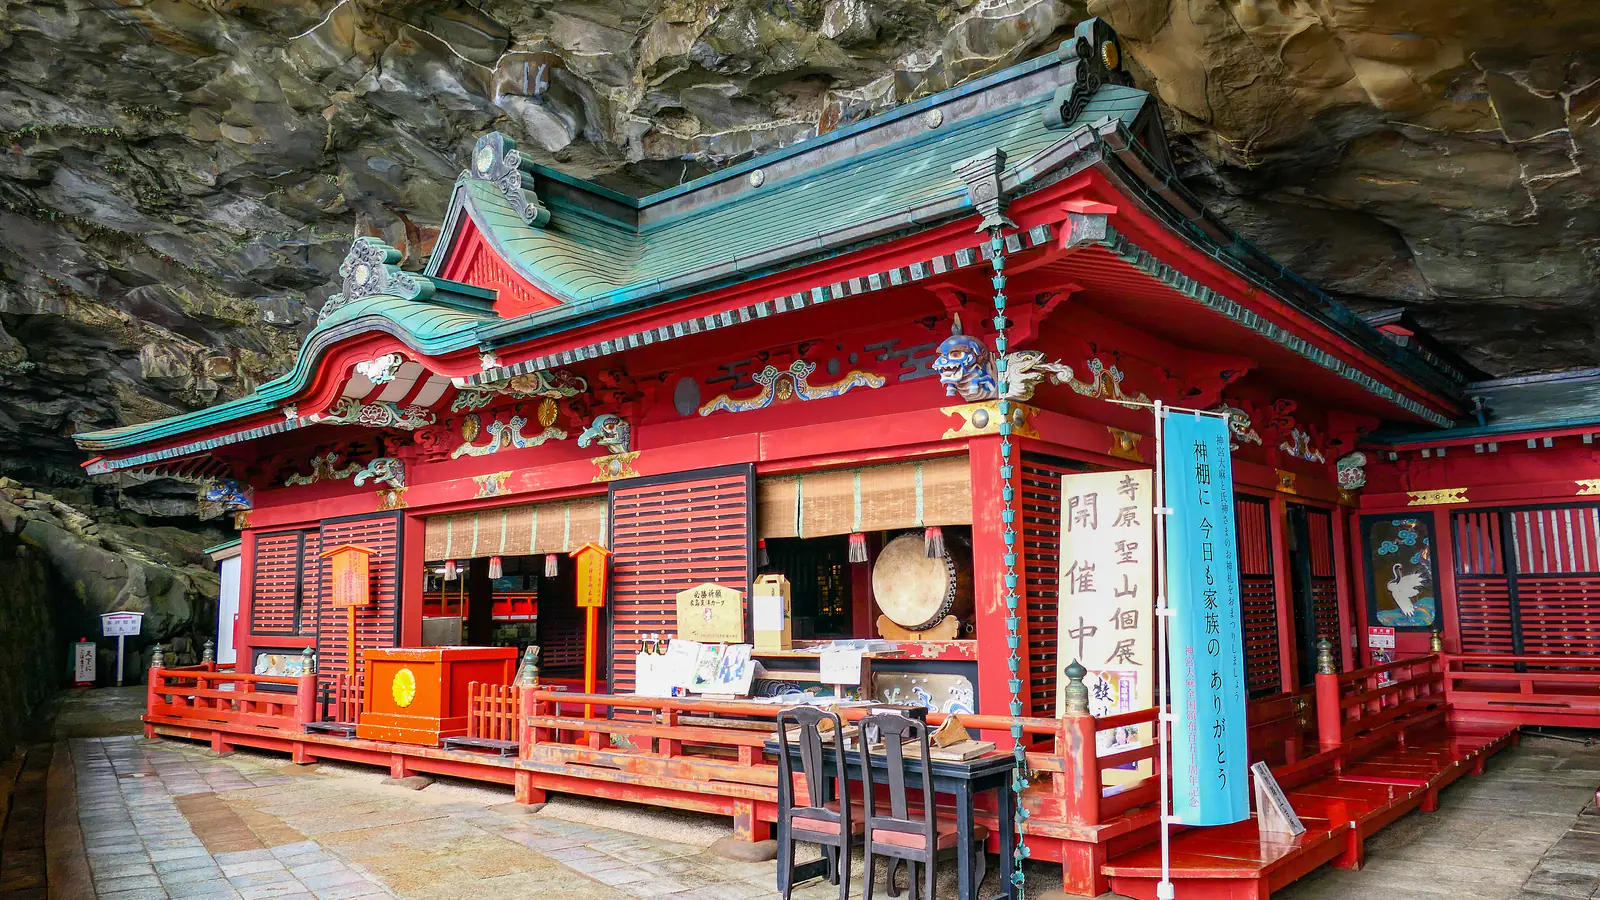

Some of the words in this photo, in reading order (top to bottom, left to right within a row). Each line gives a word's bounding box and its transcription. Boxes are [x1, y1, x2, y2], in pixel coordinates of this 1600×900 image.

[1064, 492, 1099, 661] 開催中
[1104, 474, 1143, 666] 寺原聖山個展
